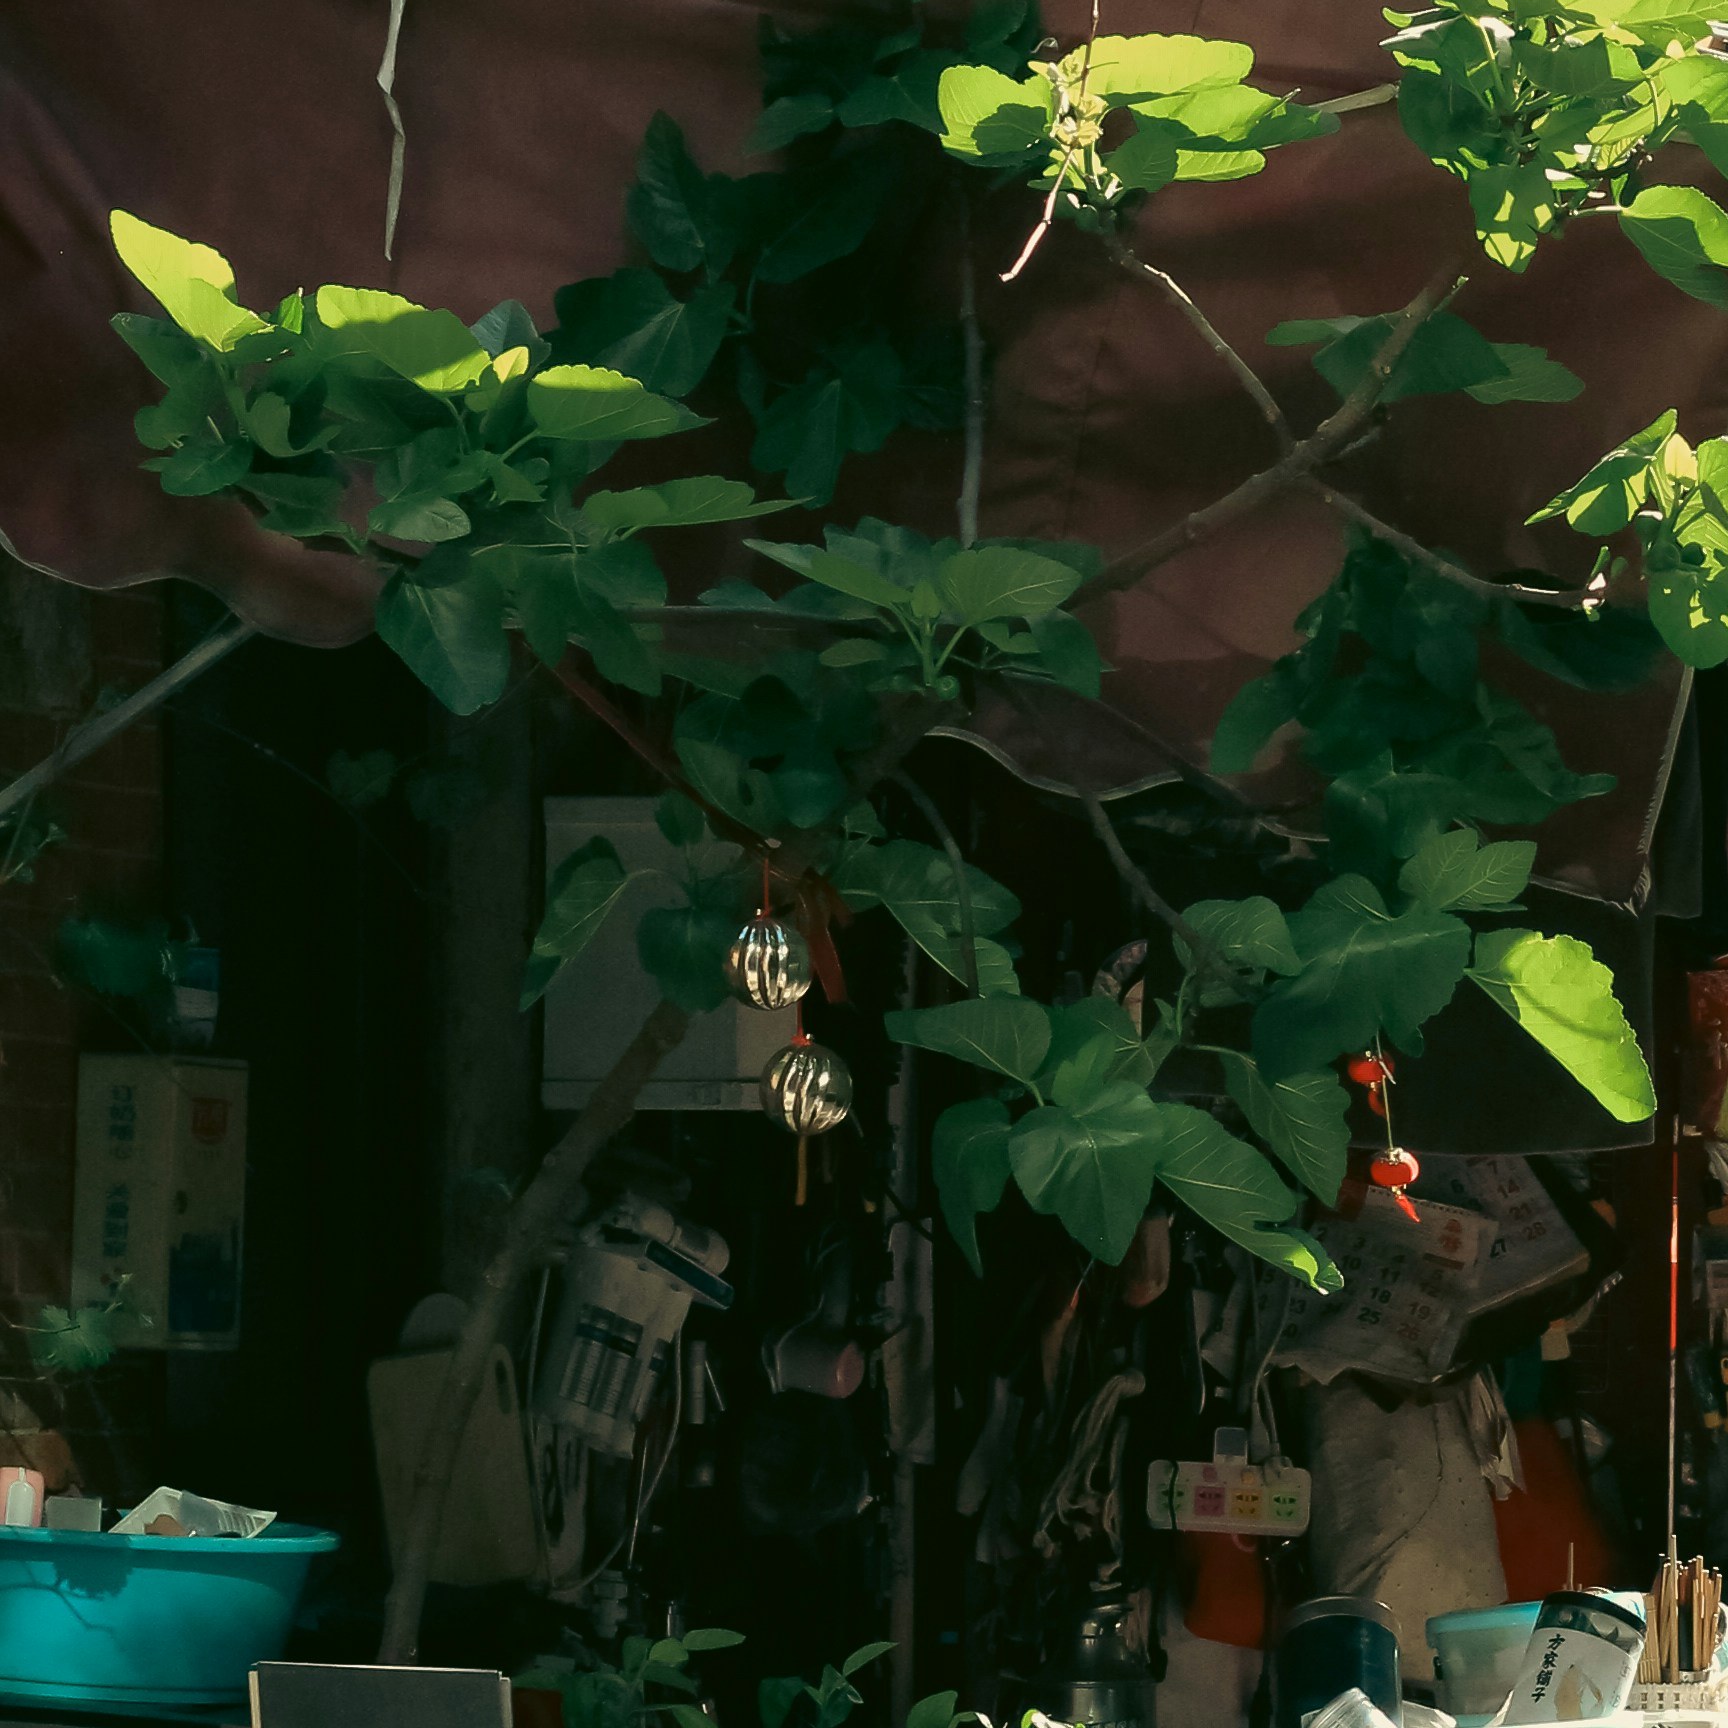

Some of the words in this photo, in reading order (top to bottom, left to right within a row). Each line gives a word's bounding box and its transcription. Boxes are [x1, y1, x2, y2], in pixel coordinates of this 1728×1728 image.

[1498, 1179, 1521, 1199] 14
[1522, 1222, 1547, 1241] 28
[1341, 1255, 1362, 1271] 10
[1370, 1287, 1392, 1304] 18
[1409, 1302, 1431, 1320] 19
[1357, 1306, 1382, 1325] 25
[1397, 1323, 1421, 1341] 26
[1530, 1633, 1566, 1703] 方家铺子
